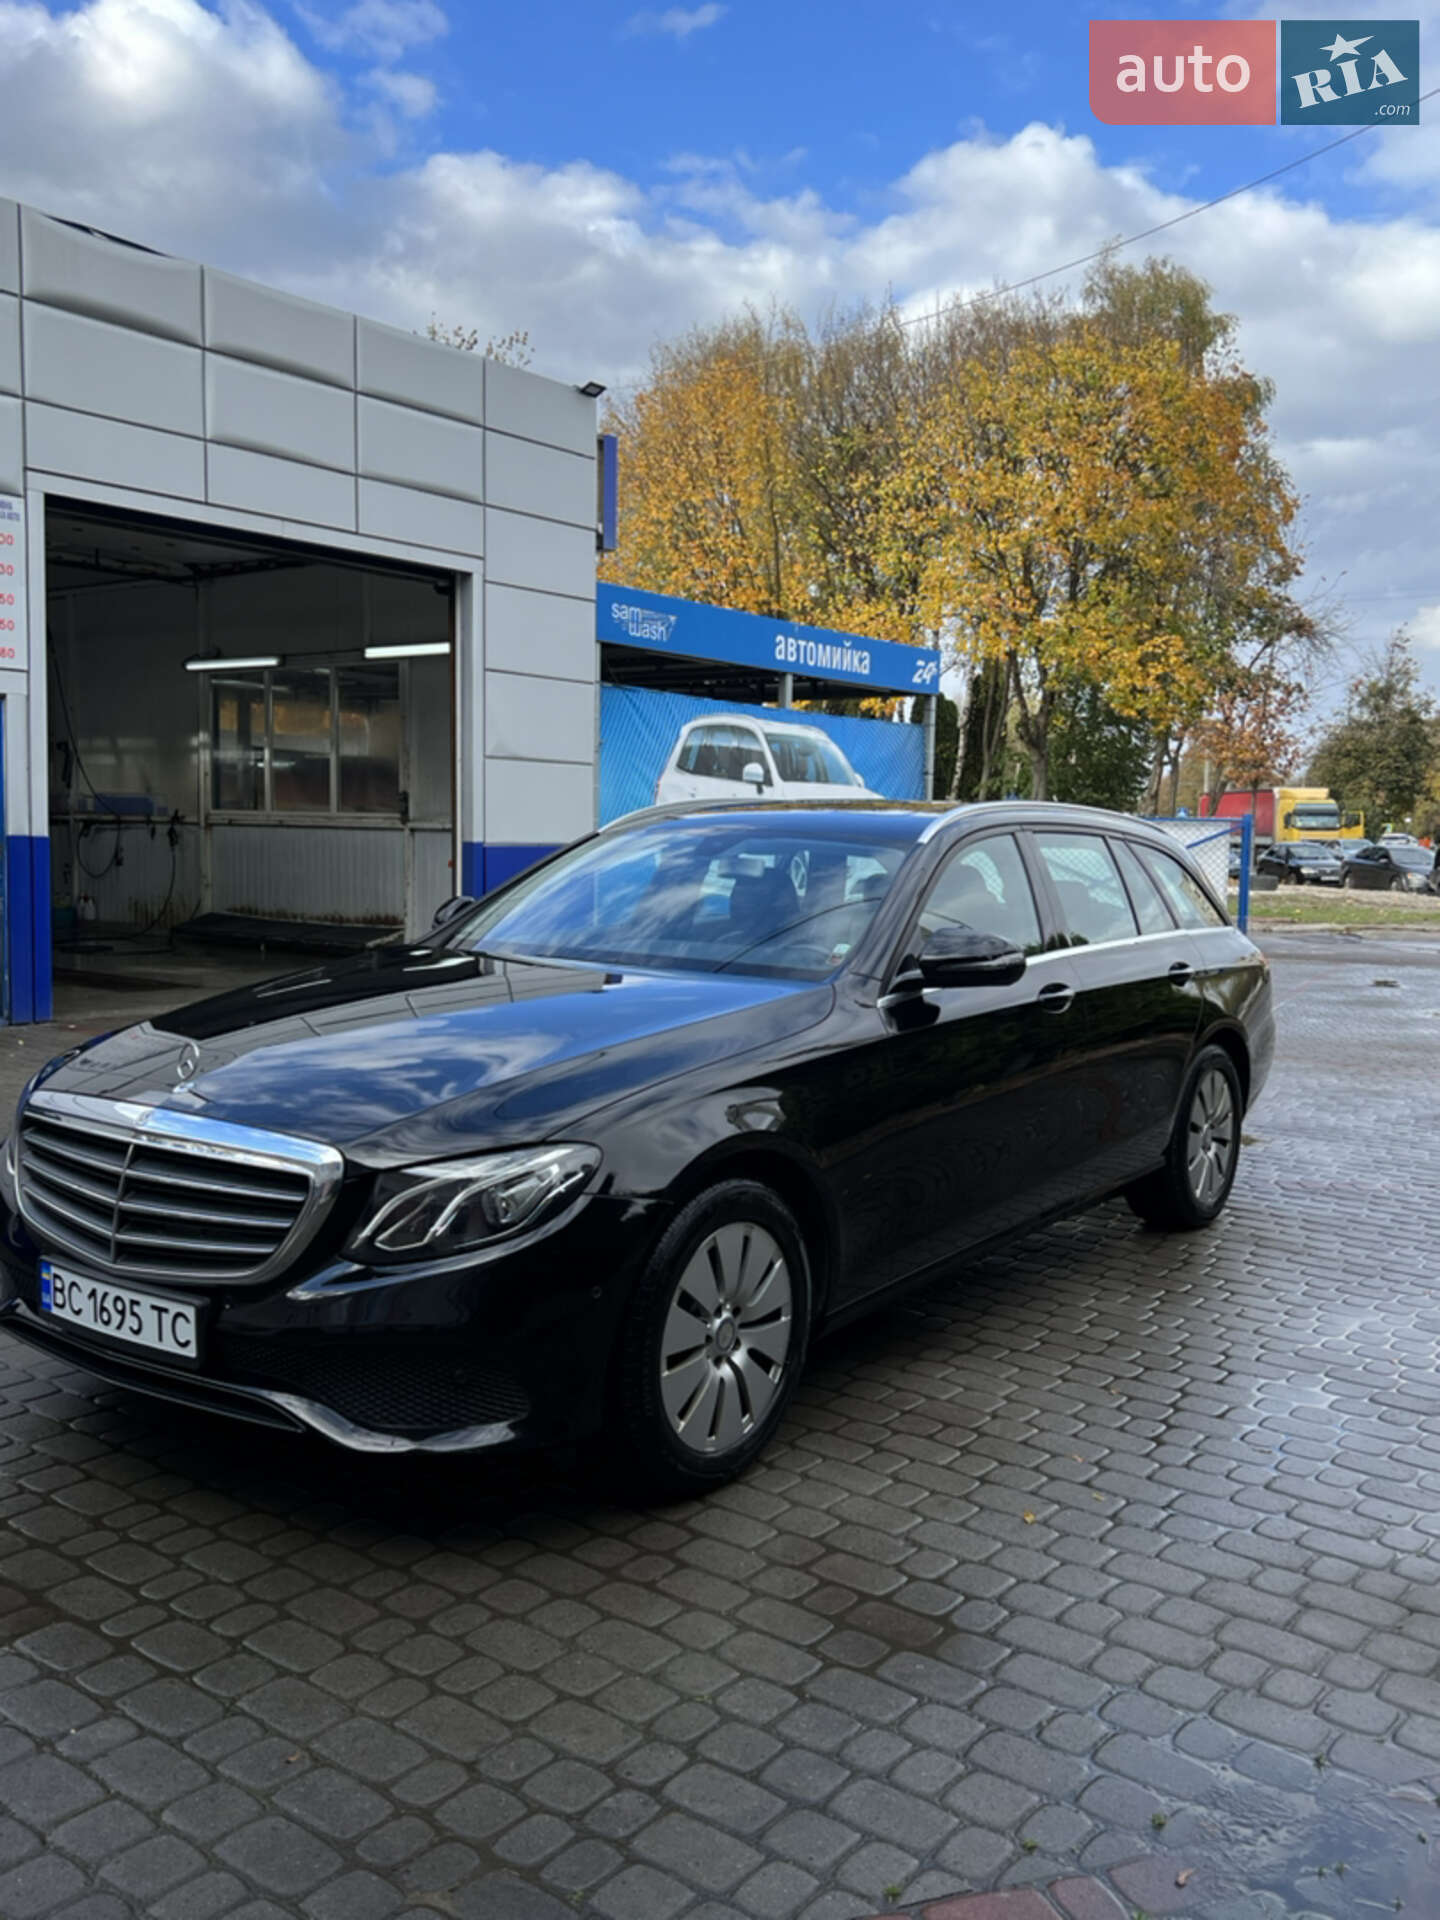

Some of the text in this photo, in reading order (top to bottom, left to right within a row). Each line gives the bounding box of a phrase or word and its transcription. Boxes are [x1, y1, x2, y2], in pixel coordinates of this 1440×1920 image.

[629, 621, 668, 643] wash
[774, 634, 871, 675] автомийка
[53, 1273, 192, 1349] BC 1695 TC
